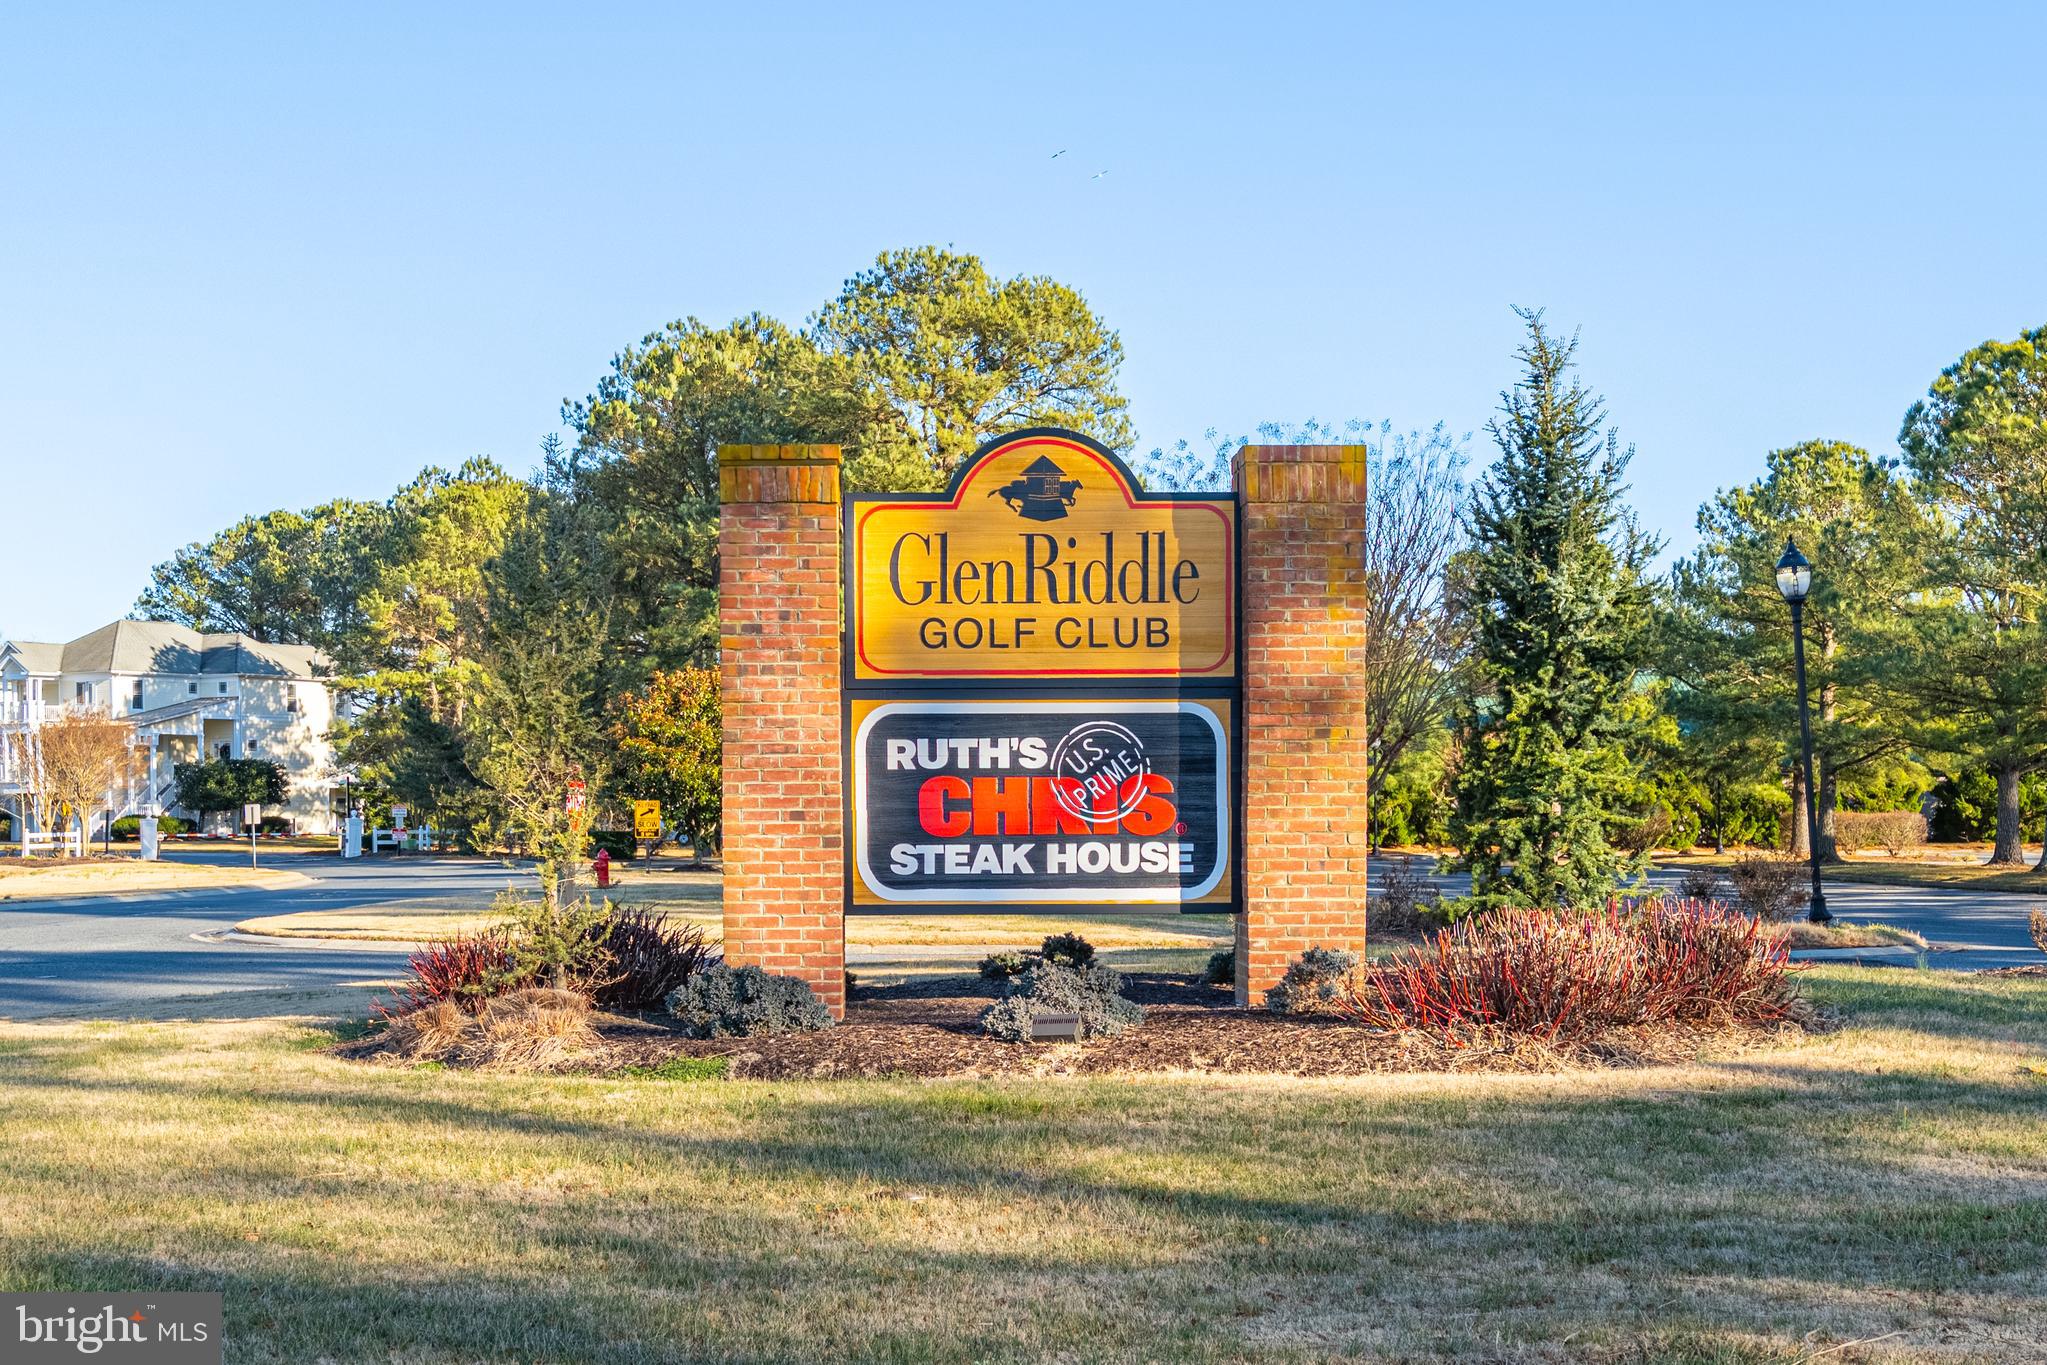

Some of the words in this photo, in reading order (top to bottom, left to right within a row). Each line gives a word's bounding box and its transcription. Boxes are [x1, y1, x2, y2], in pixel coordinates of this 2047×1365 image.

[889, 531, 1200, 606] GlenRiddle
[919, 617, 1037, 649] GOLF
[1055, 617, 1171, 649] CLUB
[886, 737, 1048, 770] RUTH'S
[1065, 738, 1110, 774] U.S.
[1072, 749, 1139, 809] PRIME
[890, 843, 1036, 876] STEAK
[1046, 841, 1195, 875] HOUSE
